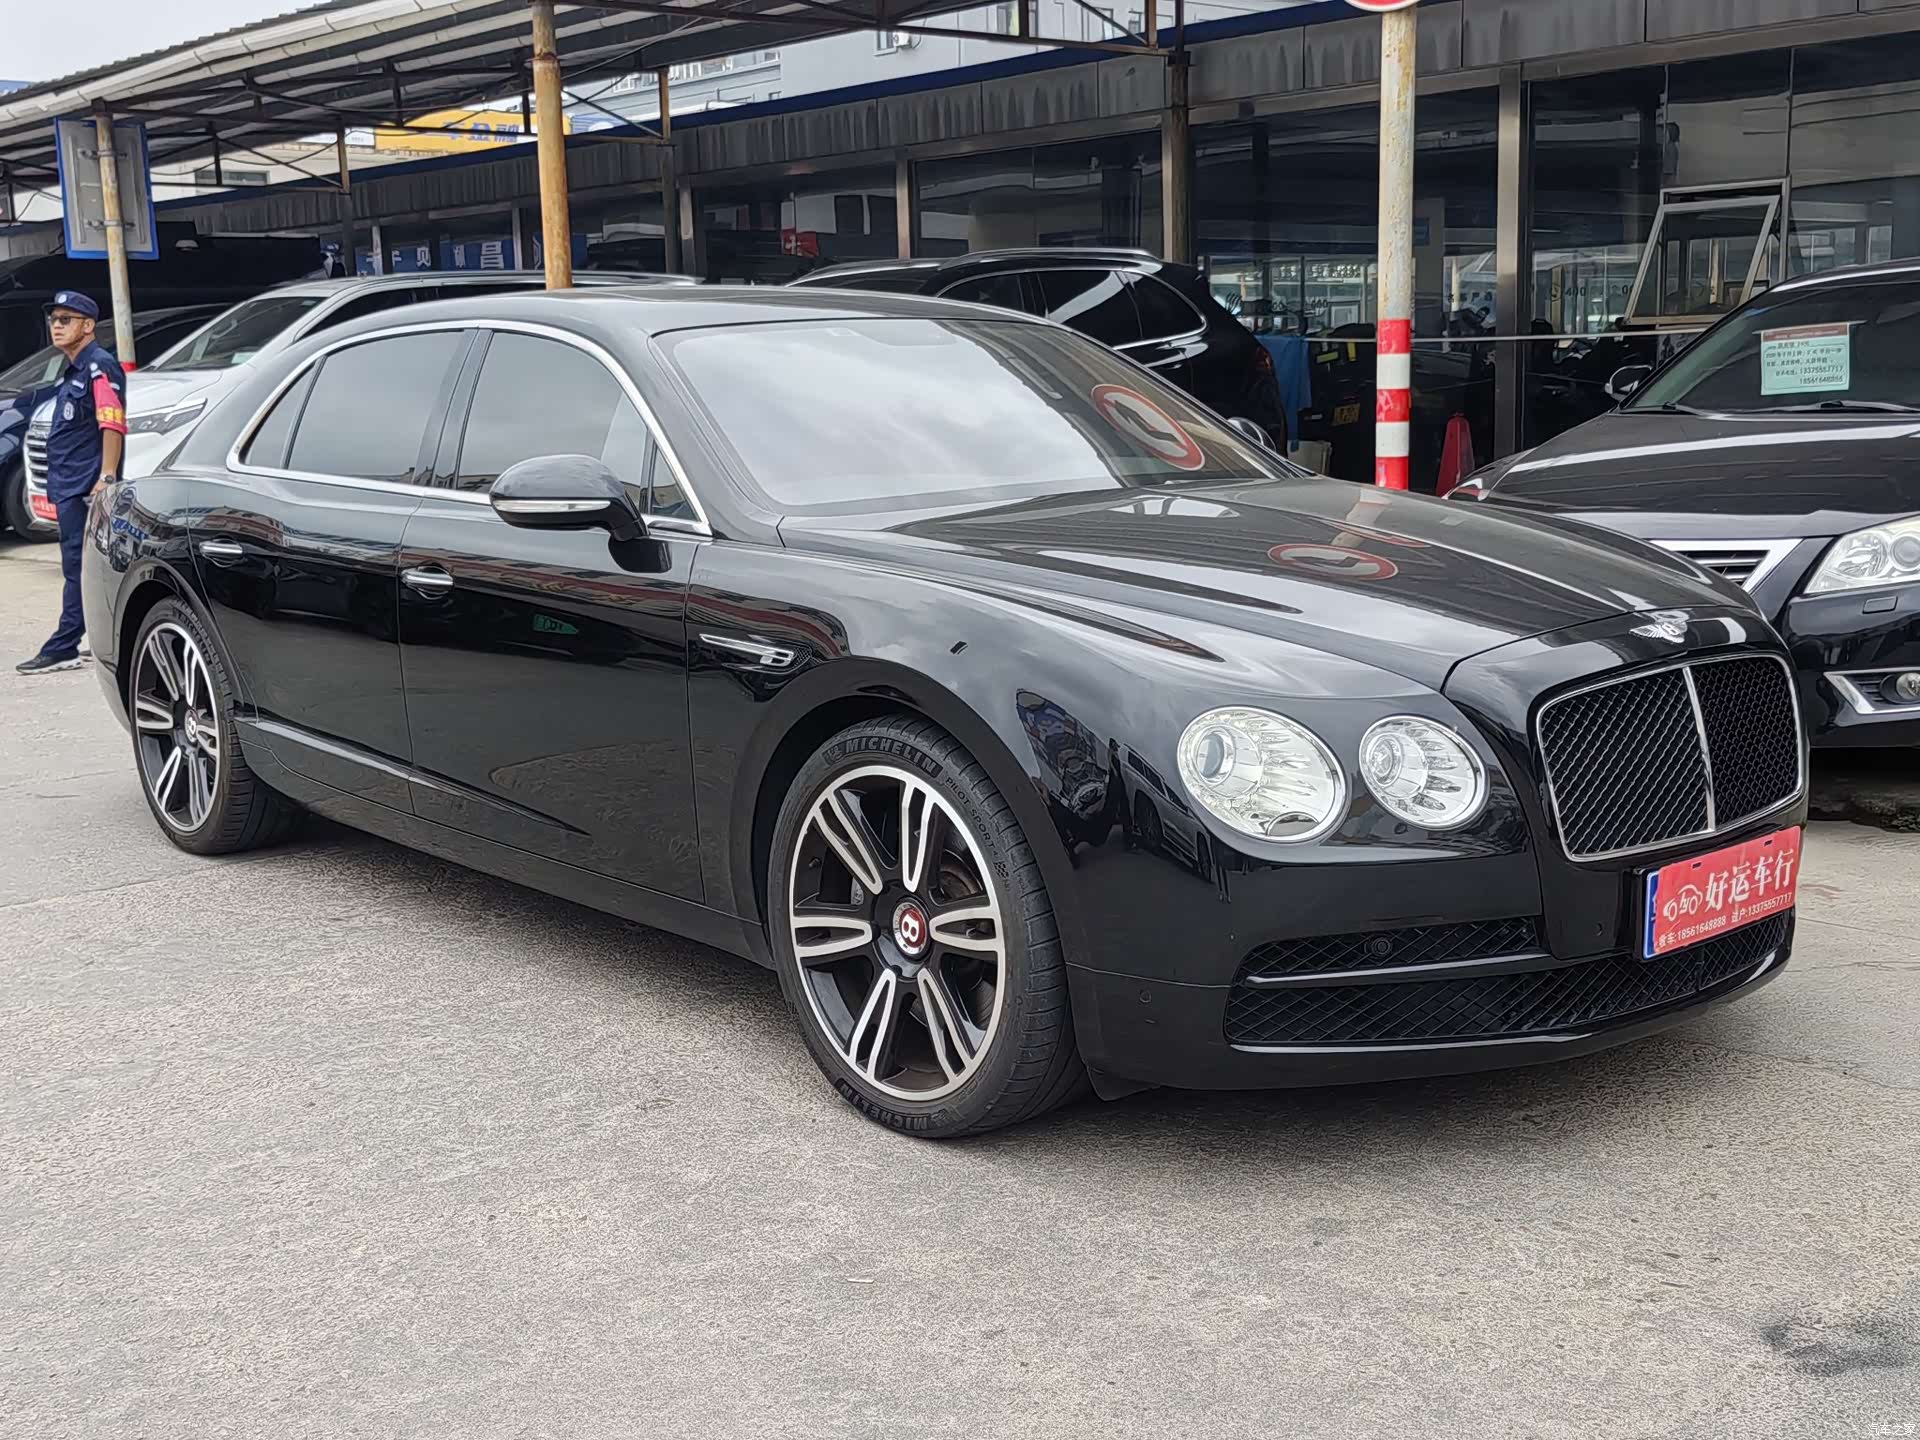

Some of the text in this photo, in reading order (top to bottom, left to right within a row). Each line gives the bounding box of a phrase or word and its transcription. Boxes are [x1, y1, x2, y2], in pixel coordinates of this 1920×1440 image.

[845, 737, 937, 774] MICHELIN
[945, 776, 971, 806] PILOT
[970, 808, 996, 849] SPORT
[1704, 848, 1795, 912] 好运车行
[840, 1082, 929, 1131] MICHELIN
